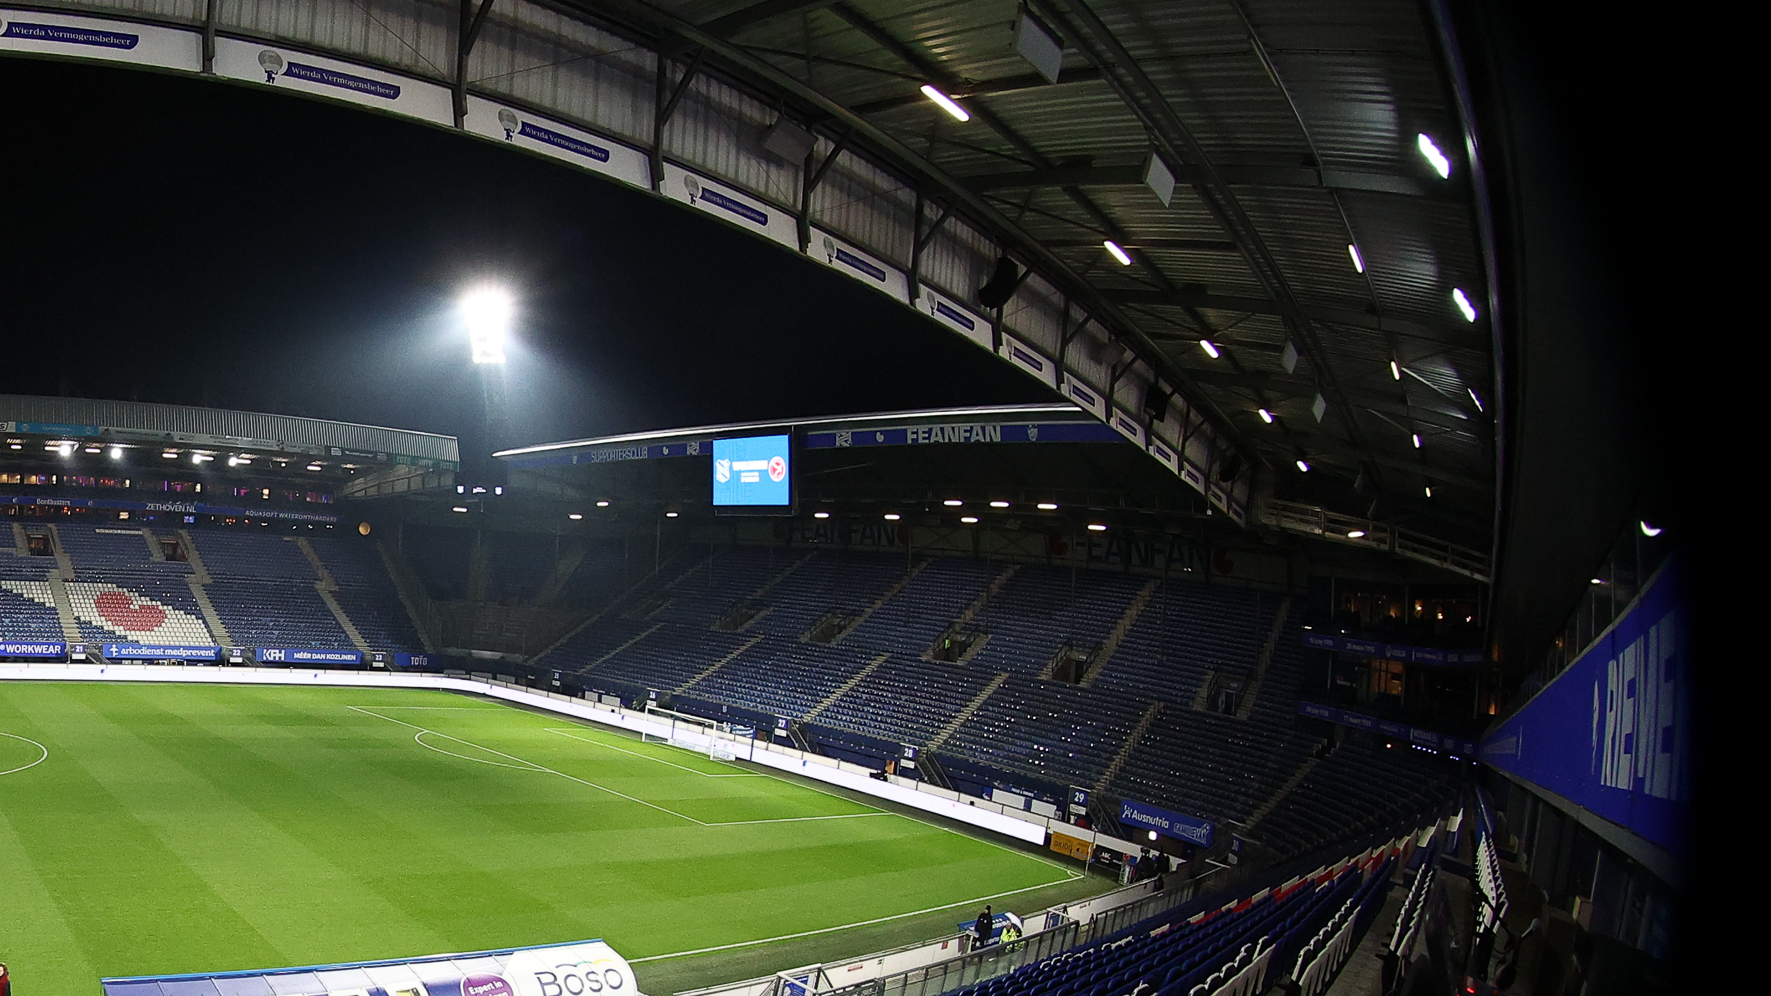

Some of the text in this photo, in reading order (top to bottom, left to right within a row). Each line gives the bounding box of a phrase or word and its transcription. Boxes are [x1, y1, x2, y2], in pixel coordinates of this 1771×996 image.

[12, 26, 131, 46] Wierda Vermogensbeheer
[291, 66, 394, 96] Wierda Vermogensbeheer
[524, 126, 606, 159] Wierda Vermogensbeheer
[906, 425, 1001, 444] FEANFAN
[591, 446, 648, 463] SUPPORTERSCLUB
[245, 510, 338, 523] AQUASOFT WATERONTHARDERS
[6, 644, 61, 655] WORKWEAR
[120, 646, 215, 658] arbodienst medprevent
[263, 649, 285, 660] KFH
[326, 653, 357, 661] KOZIJNEN
[778, 718, 787, 728] 27
[904, 748, 914, 758] 28
[1074, 792, 1085, 802] 29
[1131, 809, 1169, 829] Ausnutria
[1100, 851, 1111, 860] ABC
[468, 981, 504, 995] Expert in
